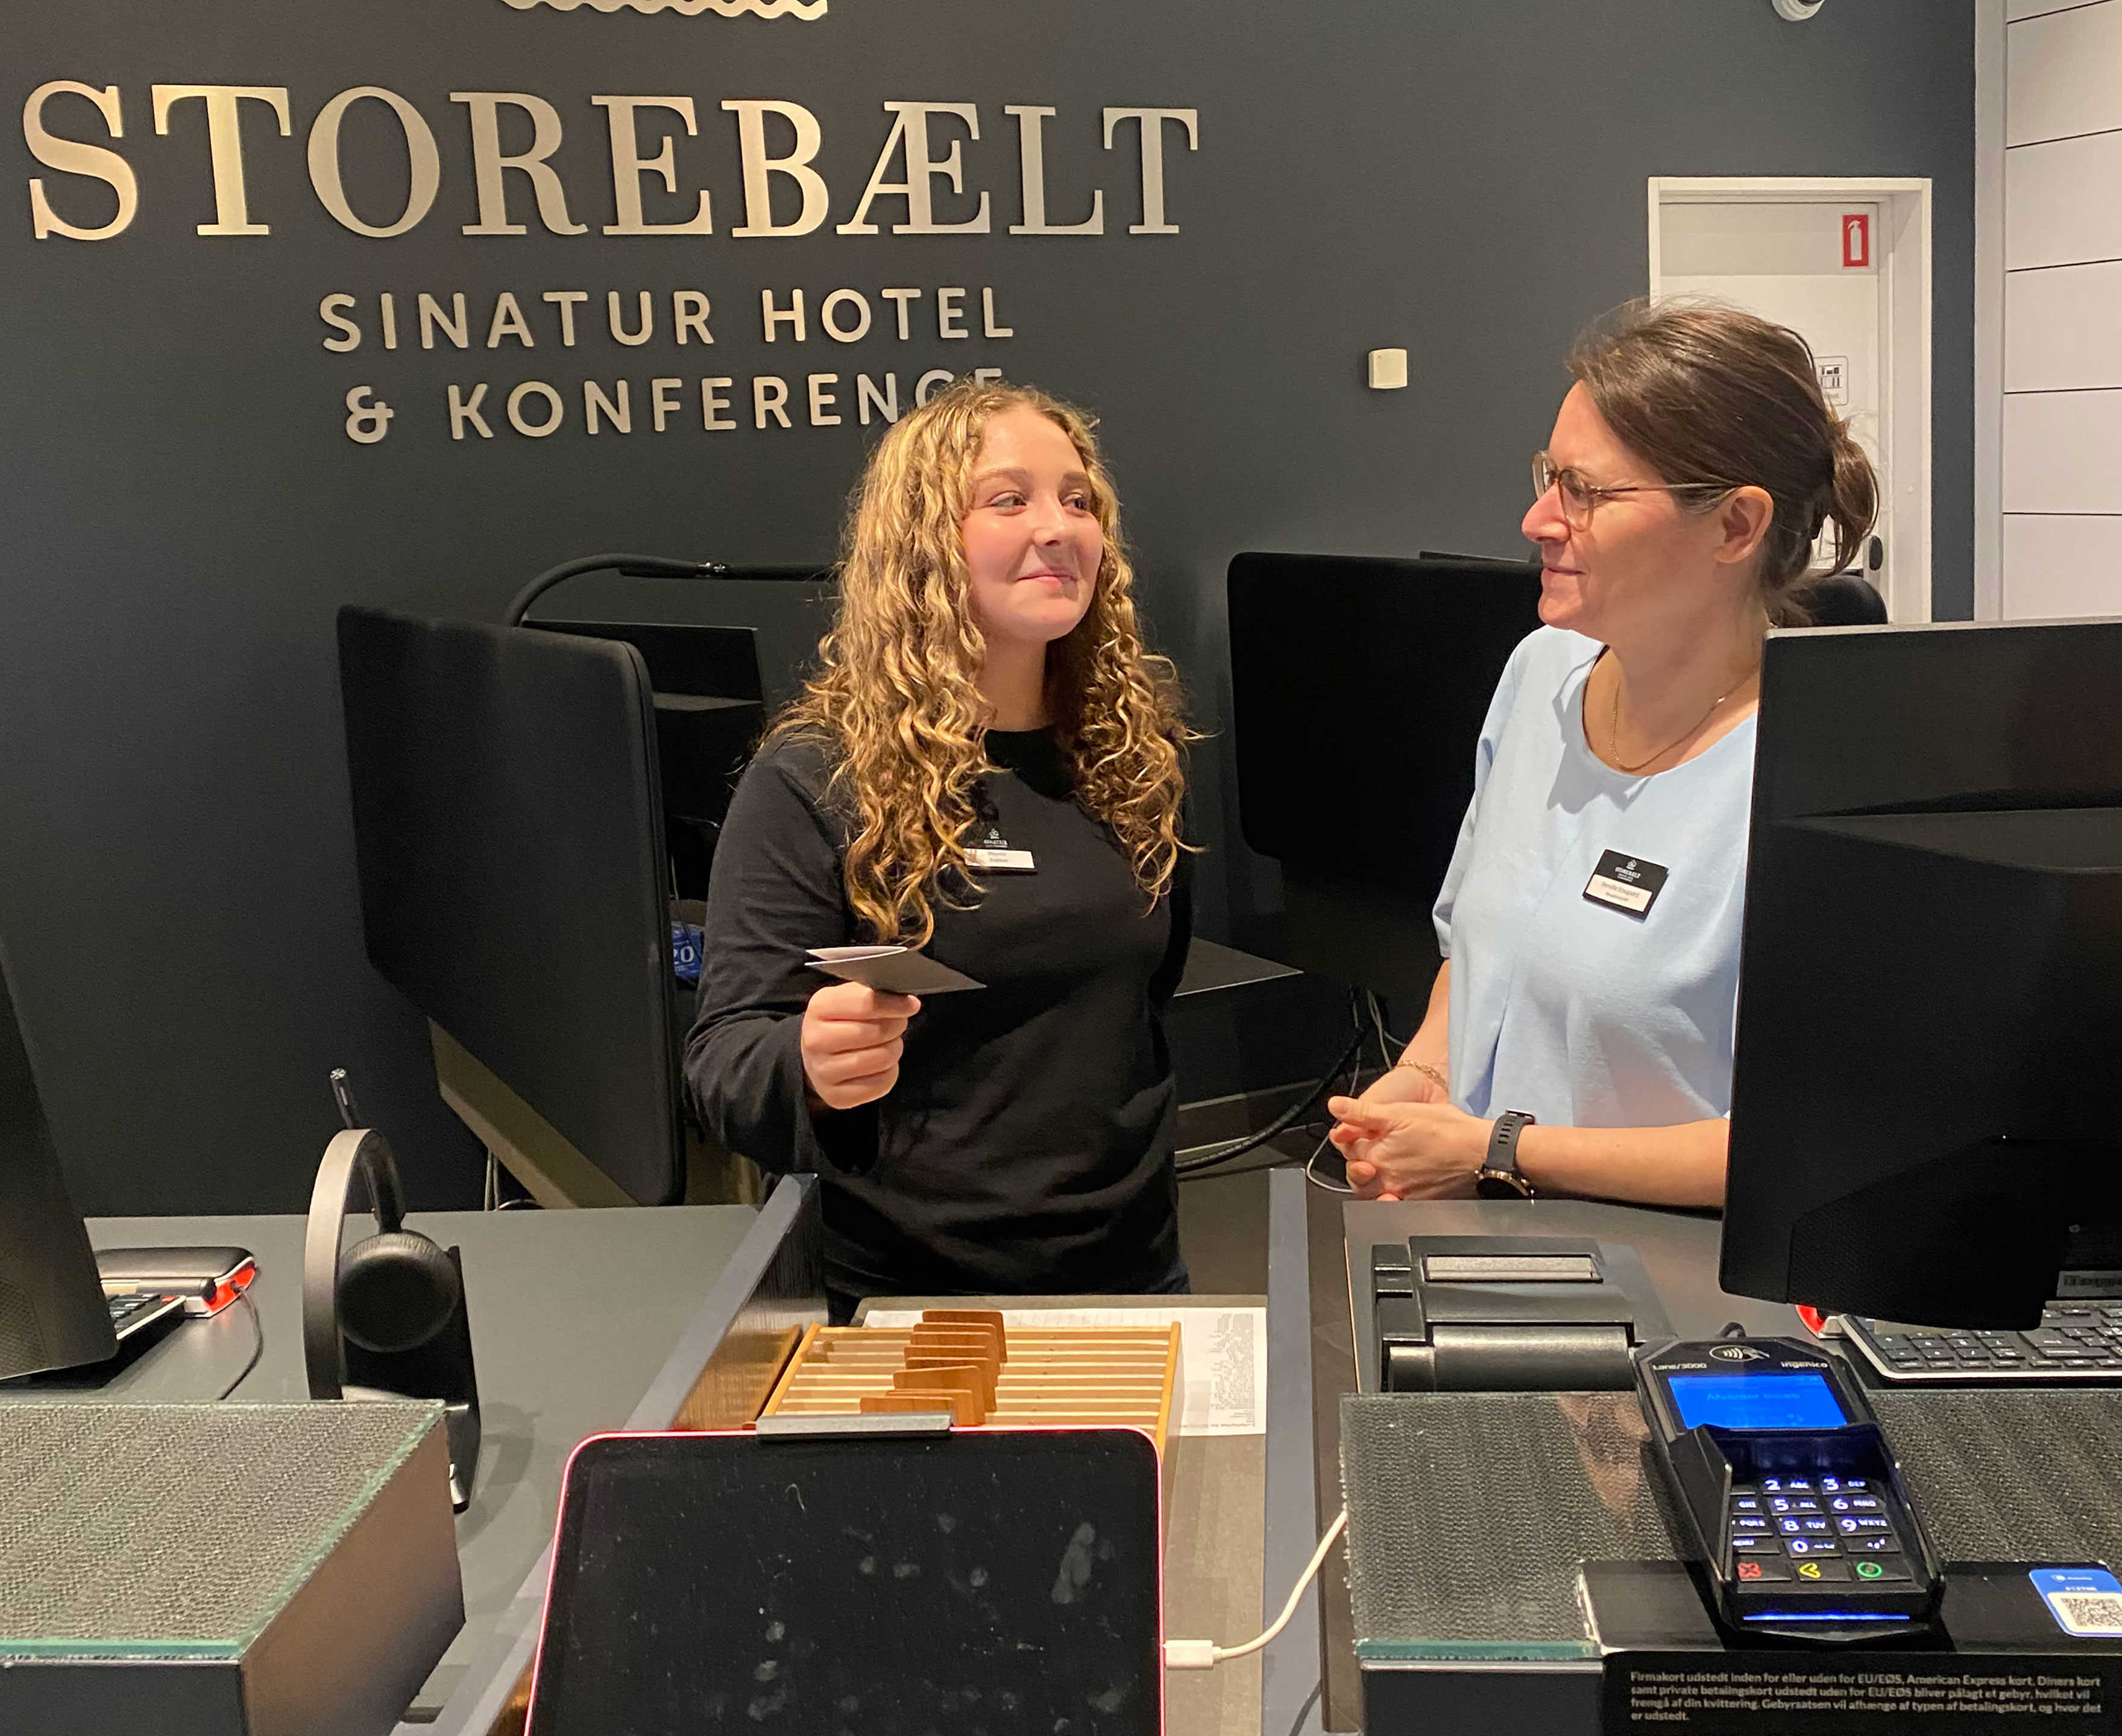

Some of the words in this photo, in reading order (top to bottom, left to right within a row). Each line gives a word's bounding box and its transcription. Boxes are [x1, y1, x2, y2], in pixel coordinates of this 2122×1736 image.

[23, 80, 1198, 241] STOREBÆLT
[319, 290, 714, 352] SINATUR
[762, 287, 1013, 343] HOTEL
[345, 385, 394, 443] &
[1765, 1479, 1781, 1491] 2
[1823, 1478, 1839, 1491] 3
[1774, 1499, 1789, 1511] 5
[1833, 1499, 1848, 1510] 6
[1784, 1520, 1799, 1531] 8
[1841, 1518, 1857, 1532] 9
[1792, 1540, 1808, 1553] 0
[1763, 1674, 1780, 1683] for
[1781, 1674, 1807, 1683] eller
[1809, 1675, 1836, 1684] uden
[1839, 1675, 1855, 1684] for
[2077, 1677, 2101, 1686] kort
[1819, 1688, 1847, 1697] uden
[1850, 1688, 1866, 1697] for
[1915, 1688, 1946, 1697] bliver
[1985, 1689, 1997, 1698] et
[2076, 1690, 2090, 1699] vil
[1672, 1699, 1682, 1708] af
[1684, 1699, 1702, 1708] din
[1833, 1700, 1847, 1709] vil
[1899, 1700, 1910, 1709] af
[1912, 1700, 1944, 1711] typen
[1946, 1701, 1957, 1710] af
[2038, 1704, 2053, 1712] og
[2055, 1702, 2080, 1711] hvor
[2082, 1702, 2102, 1711] det
